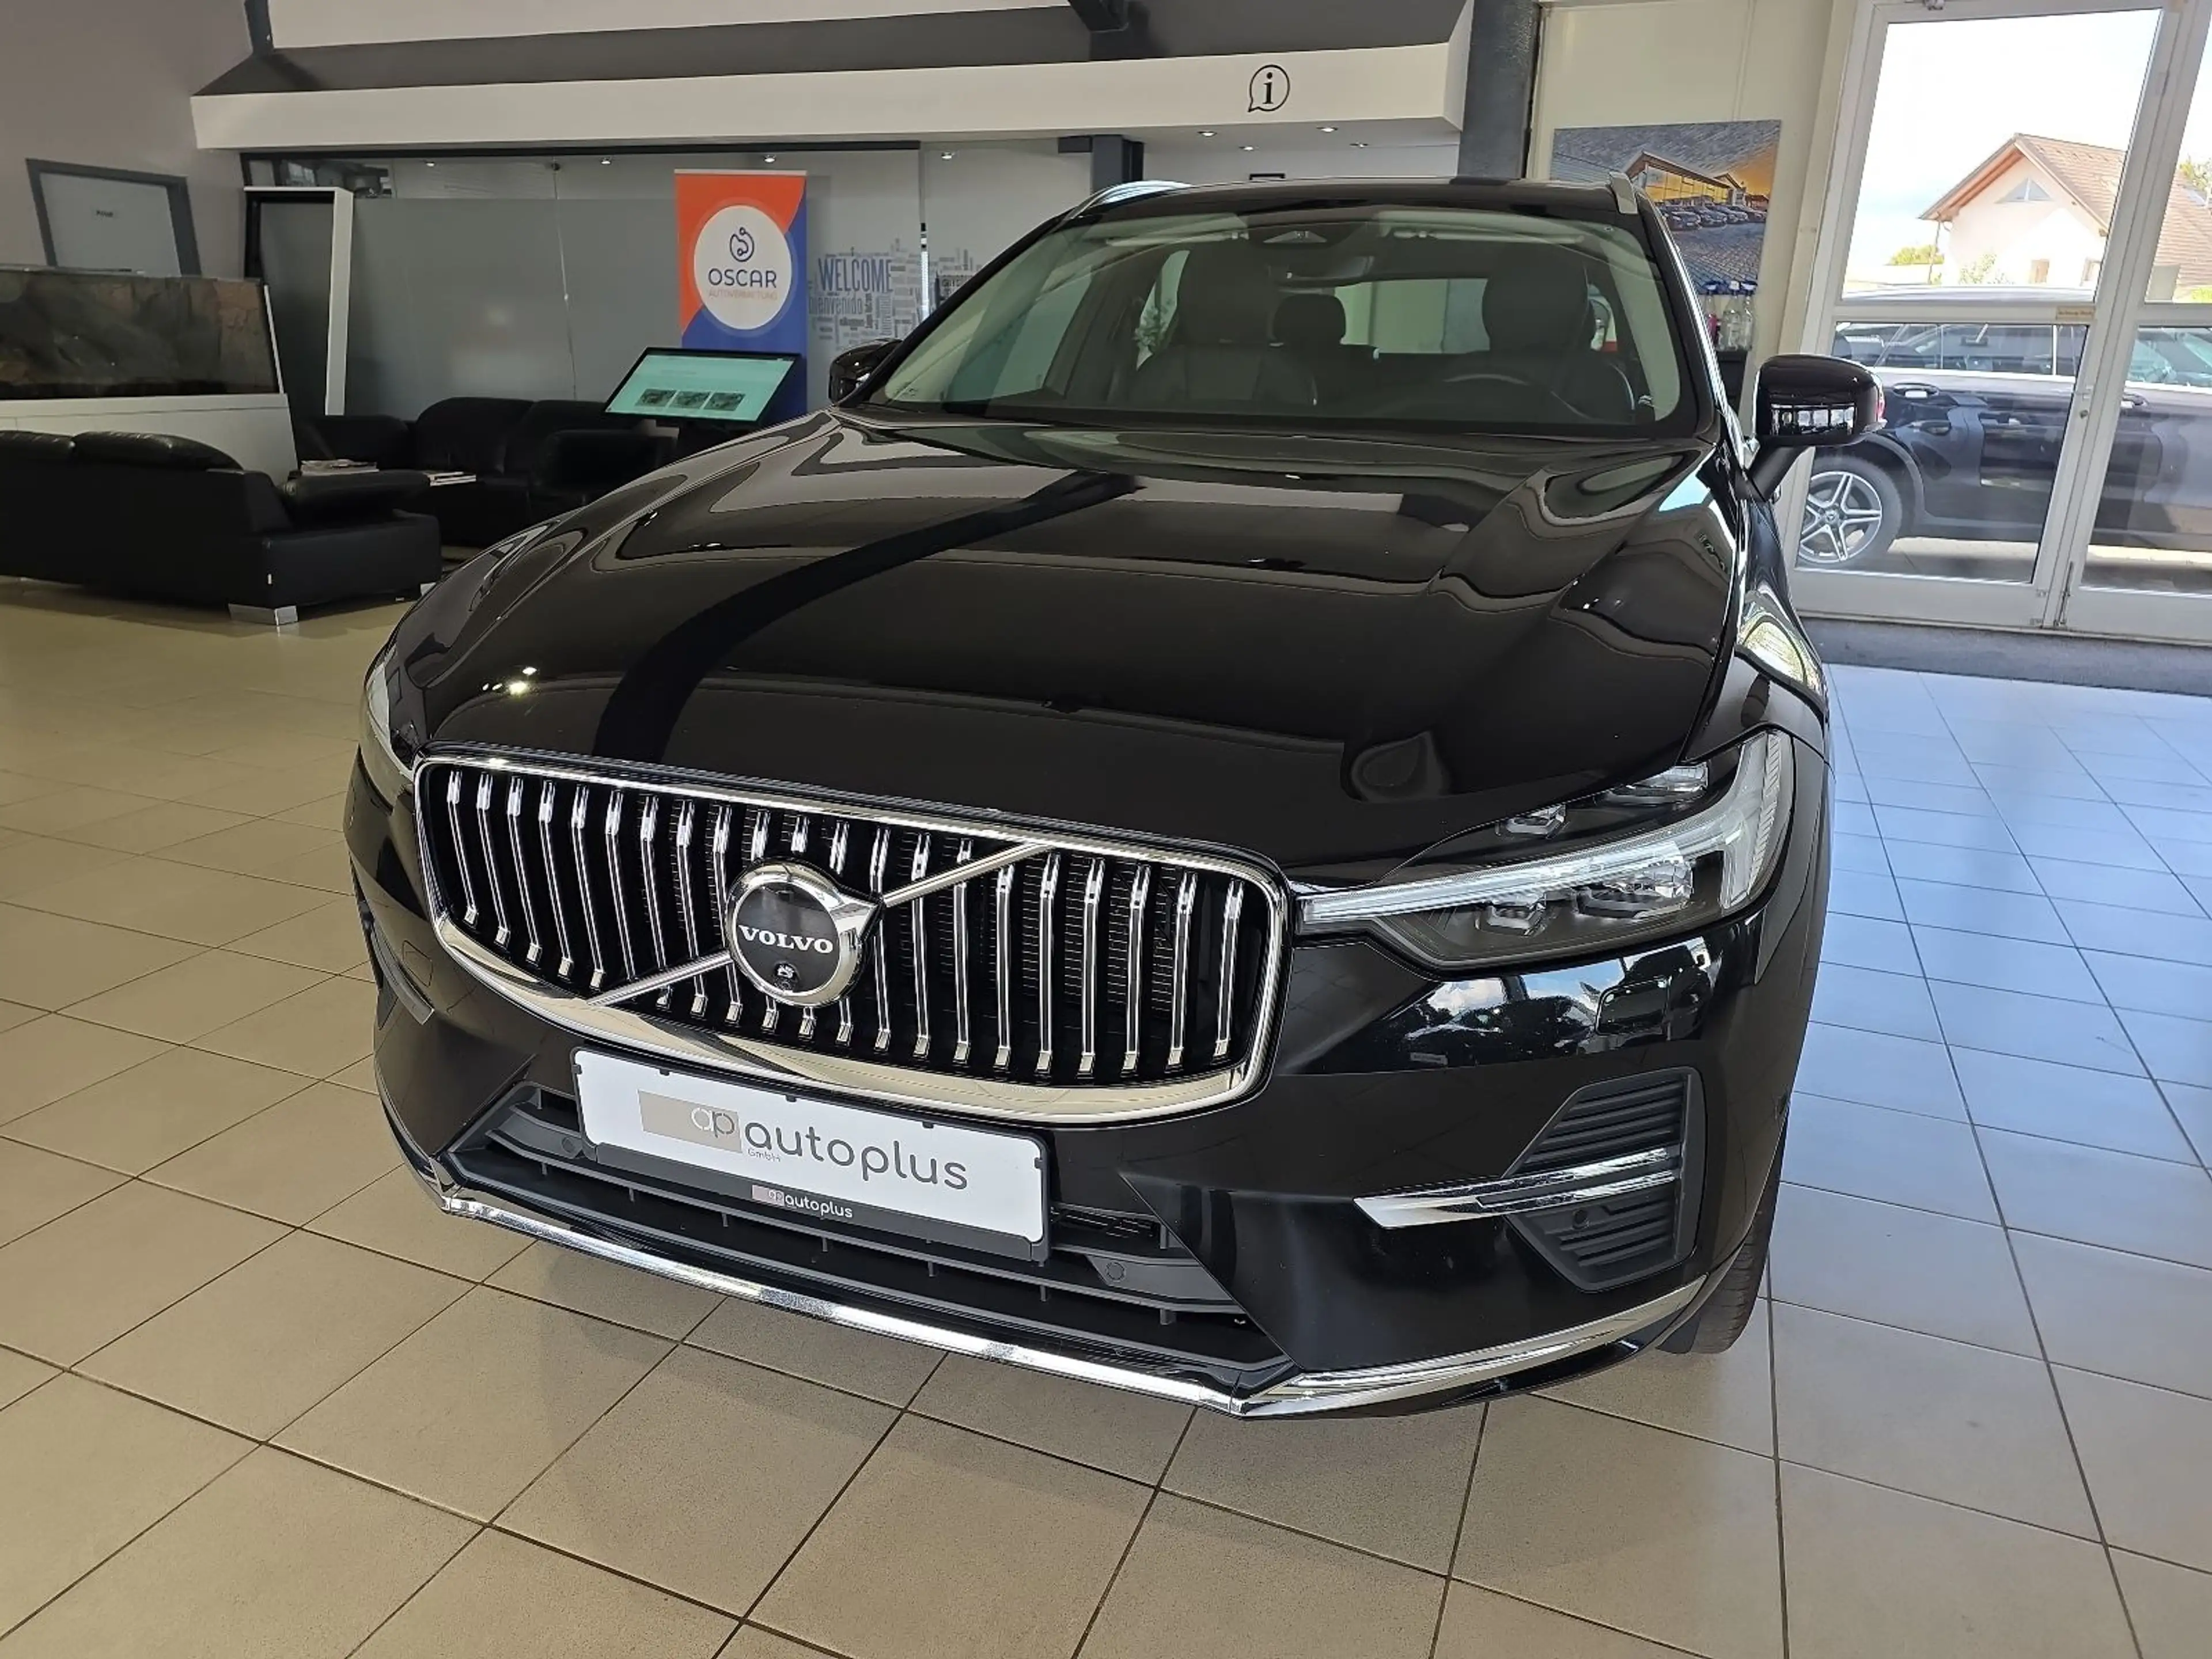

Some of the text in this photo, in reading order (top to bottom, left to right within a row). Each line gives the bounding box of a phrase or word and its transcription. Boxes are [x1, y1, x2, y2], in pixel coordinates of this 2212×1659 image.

[708, 268, 777, 288] OSCAR
[818, 257, 893, 293] WELCOME
[738, 925, 834, 954] VOLVO
[745, 1122, 968, 1190] autoplus
[748, 1148, 781, 1162] GmbH
[785, 1194, 853, 1218] autoplus
